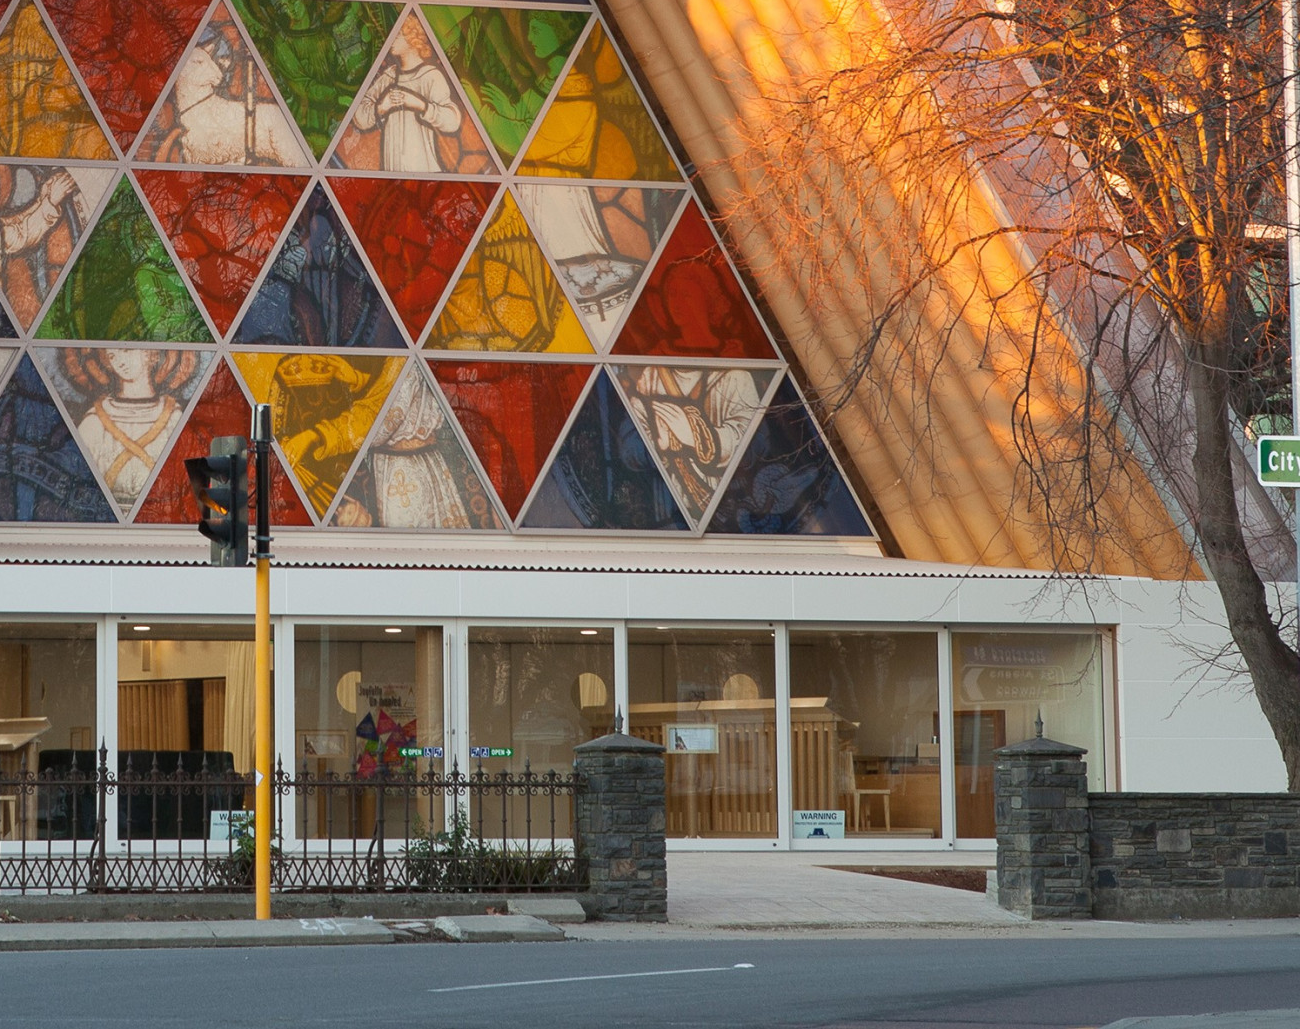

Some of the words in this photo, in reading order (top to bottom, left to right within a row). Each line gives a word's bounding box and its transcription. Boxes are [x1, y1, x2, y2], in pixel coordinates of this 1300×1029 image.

[408, 748, 422, 756] OPEN
[491, 748, 505, 756] OPEN
[800, 812, 838, 820] WARNING
